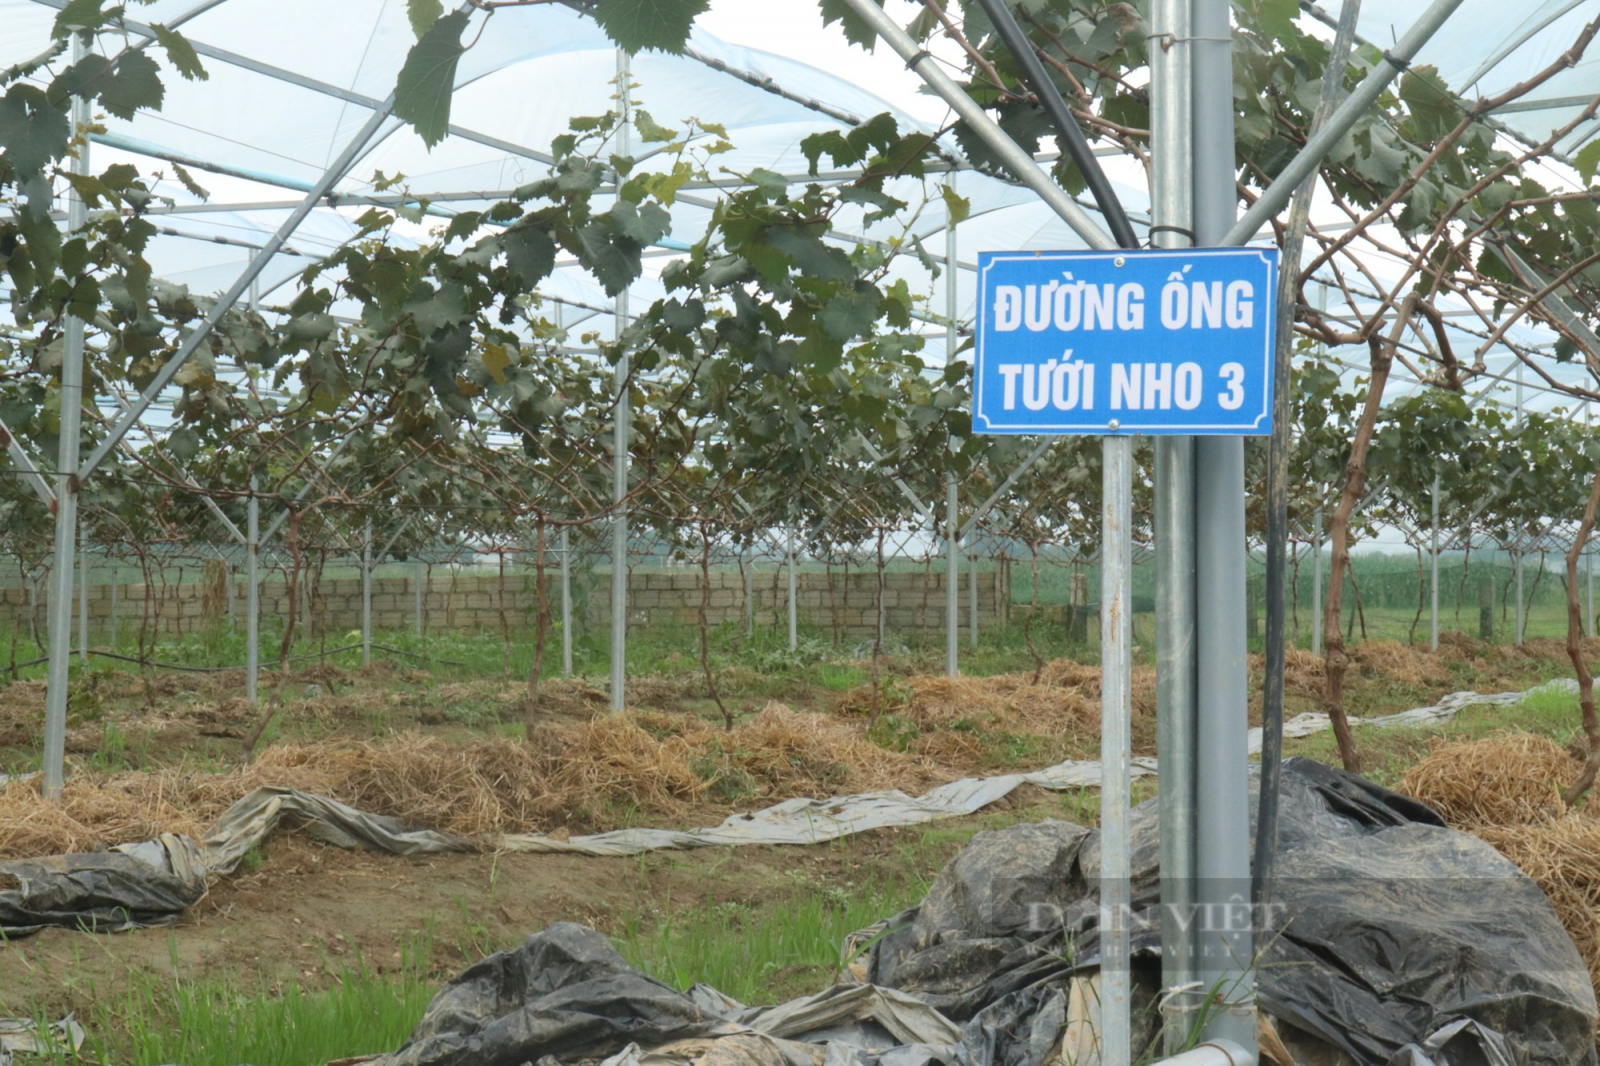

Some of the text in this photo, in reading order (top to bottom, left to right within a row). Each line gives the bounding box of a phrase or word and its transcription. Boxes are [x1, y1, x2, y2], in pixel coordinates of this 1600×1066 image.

[993, 264, 1255, 332] ĐƯỜNG ỐNG
[998, 349, 1246, 411] TƯỚI NHO 3
